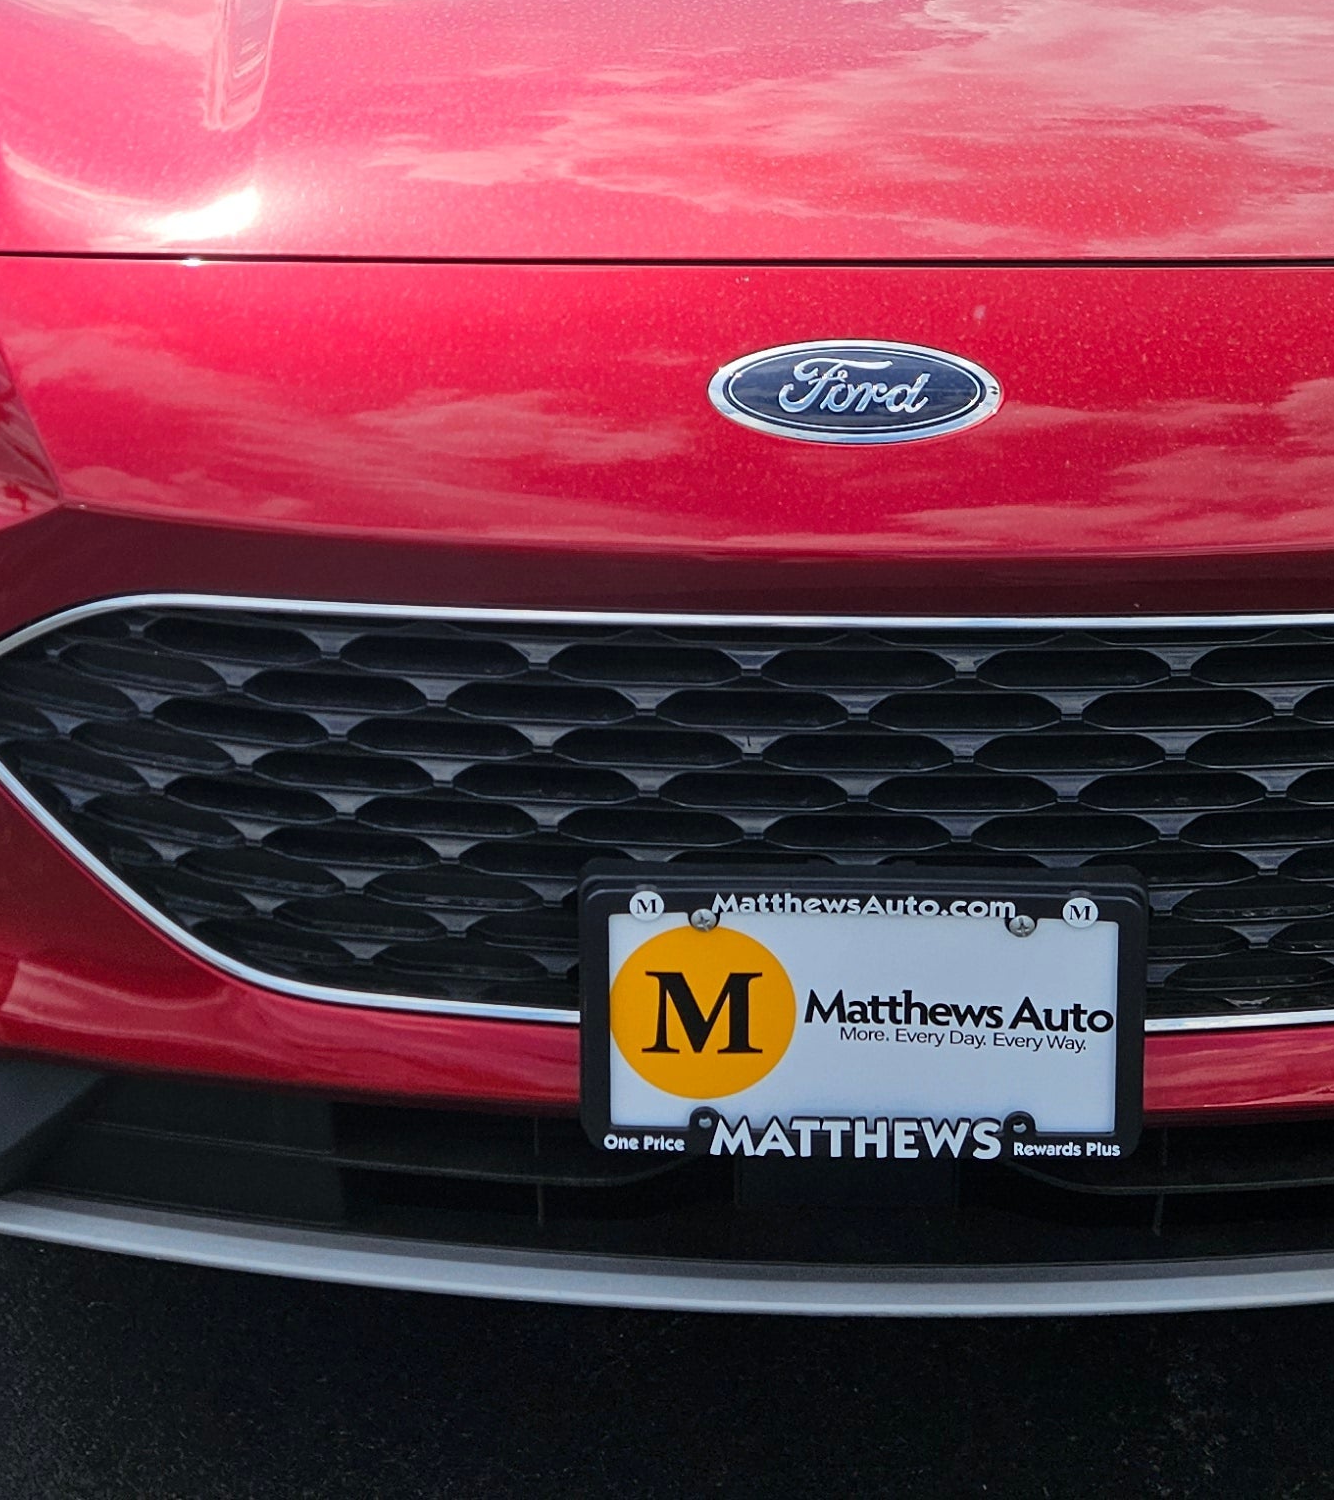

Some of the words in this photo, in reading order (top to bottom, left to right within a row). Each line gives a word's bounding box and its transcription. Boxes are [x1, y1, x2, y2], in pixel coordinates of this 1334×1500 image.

[778, 357, 931, 413] Ford
[636, 899, 657, 914] M
[711, 893, 1017, 919] MatthewsAuto.com
[1069, 905, 1091, 921] M
[642, 971, 764, 1054] M
[804, 989, 1004, 1029] Matthews
[1008, 996, 1115, 1033] Auto
[840, 1027, 890, 1042] More.
[895, 1028, 945, 1048] Every
[949, 1030, 987, 1048] Day.
[993, 1032, 1043, 1052] Every
[1046, 1035, 1087, 1053] Way.
[603, 1134, 639, 1150] One
[643, 1134, 686, 1151] Price
[709, 1117, 1002, 1158] MATTHEWS
[1013, 1141, 1082, 1157] Rewards
[1086, 1142, 1121, 1157] Plus
